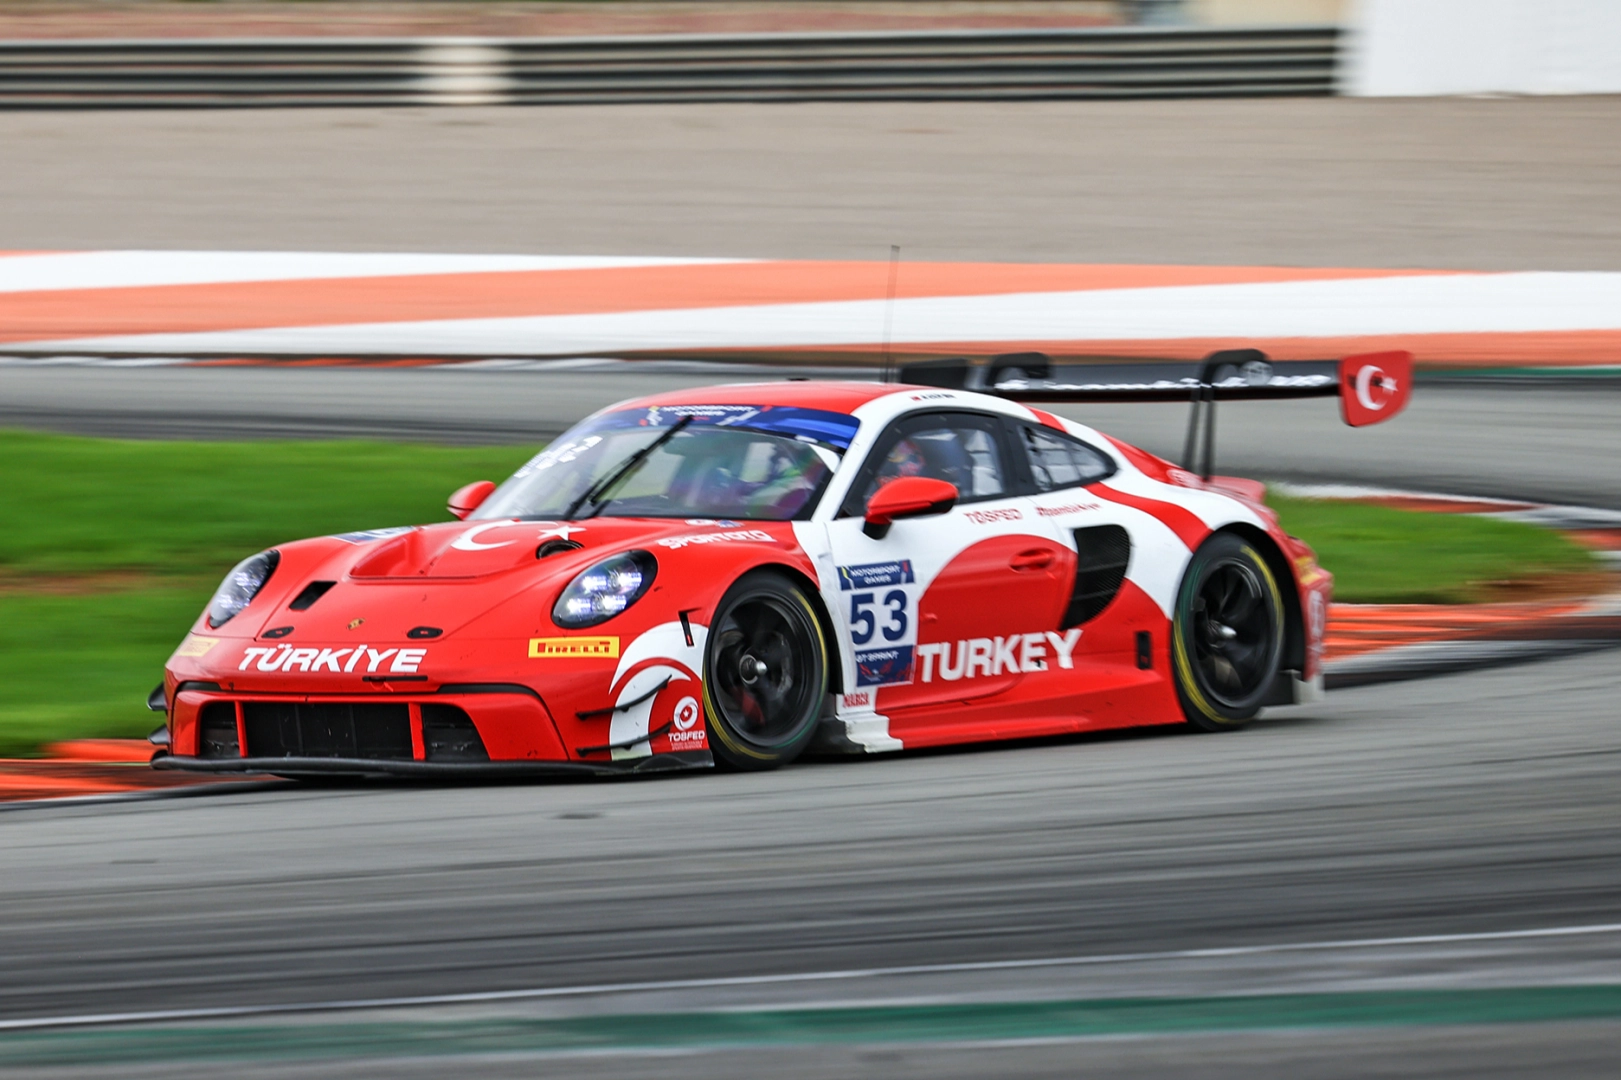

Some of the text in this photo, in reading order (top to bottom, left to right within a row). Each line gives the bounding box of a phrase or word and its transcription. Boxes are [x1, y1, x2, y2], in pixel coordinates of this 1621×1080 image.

[850, 589, 908, 645] 53
[238, 643, 428, 673] TÜRKİYE
[535, 640, 612, 654] PIRELLI
[917, 628, 1083, 683] TURKEY
[668, 730, 705, 742] TOSFED
